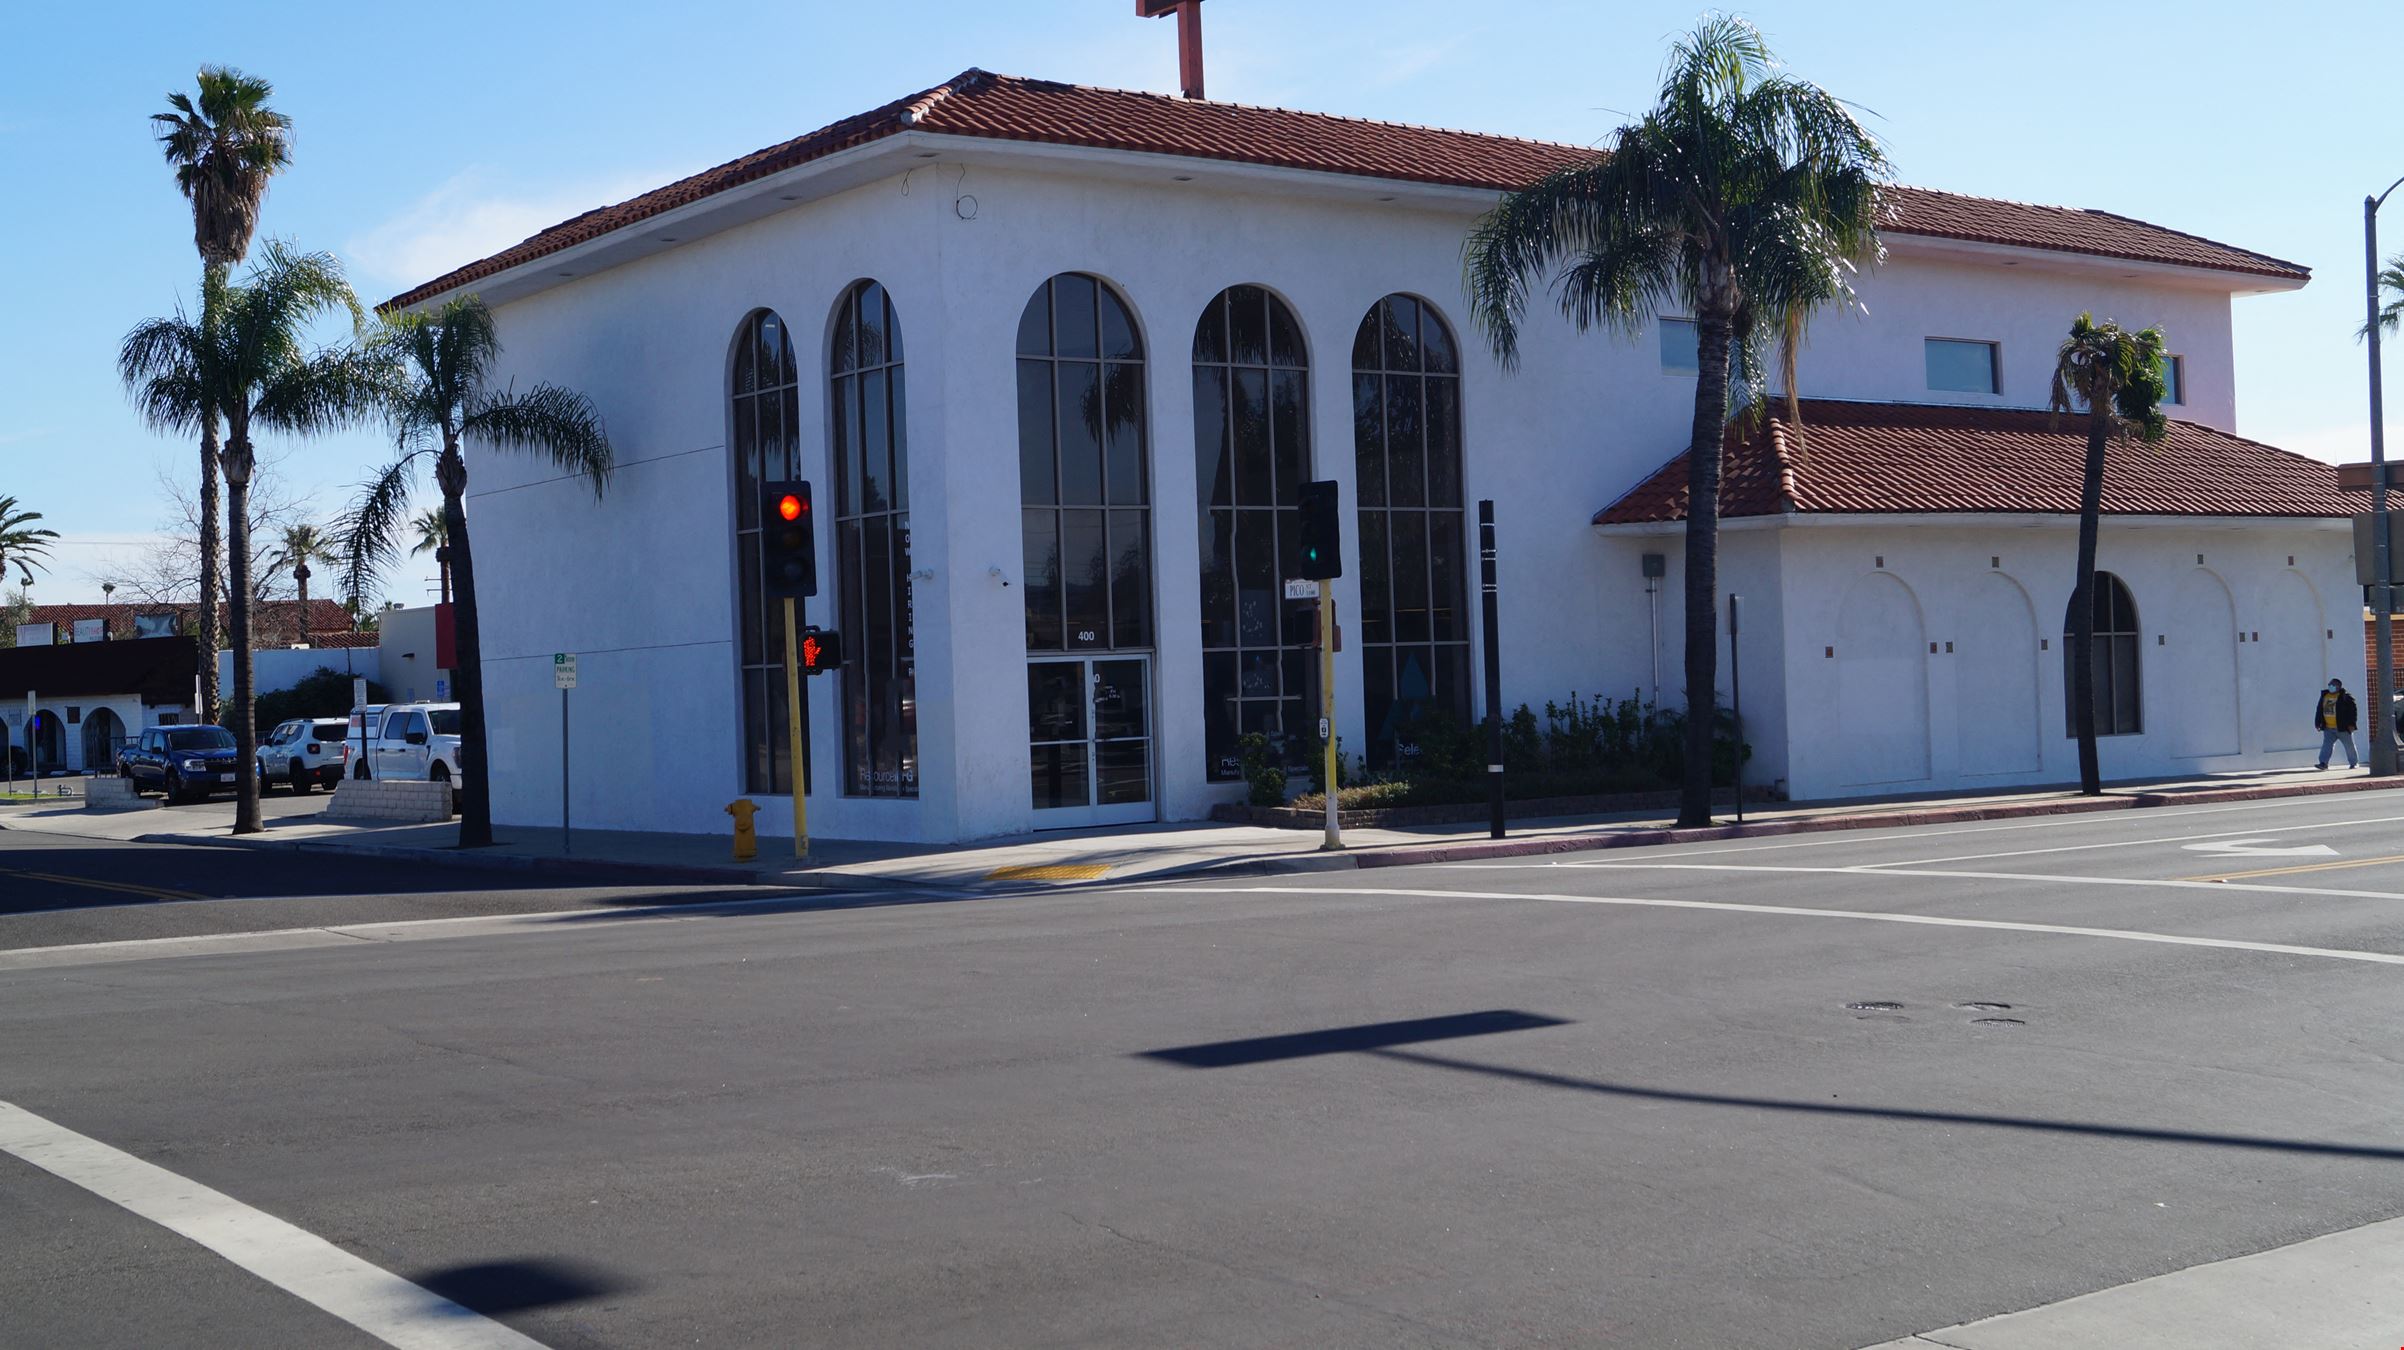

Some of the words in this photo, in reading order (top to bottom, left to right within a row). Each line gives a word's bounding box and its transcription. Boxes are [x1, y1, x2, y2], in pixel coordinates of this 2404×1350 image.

[1289, 584, 1305, 597] PICO
[906, 573, 914, 648] HIRING
[1078, 631, 1095, 641] 400
[557, 654, 563, 663] 2
[556, 665, 575, 673] PARKING
